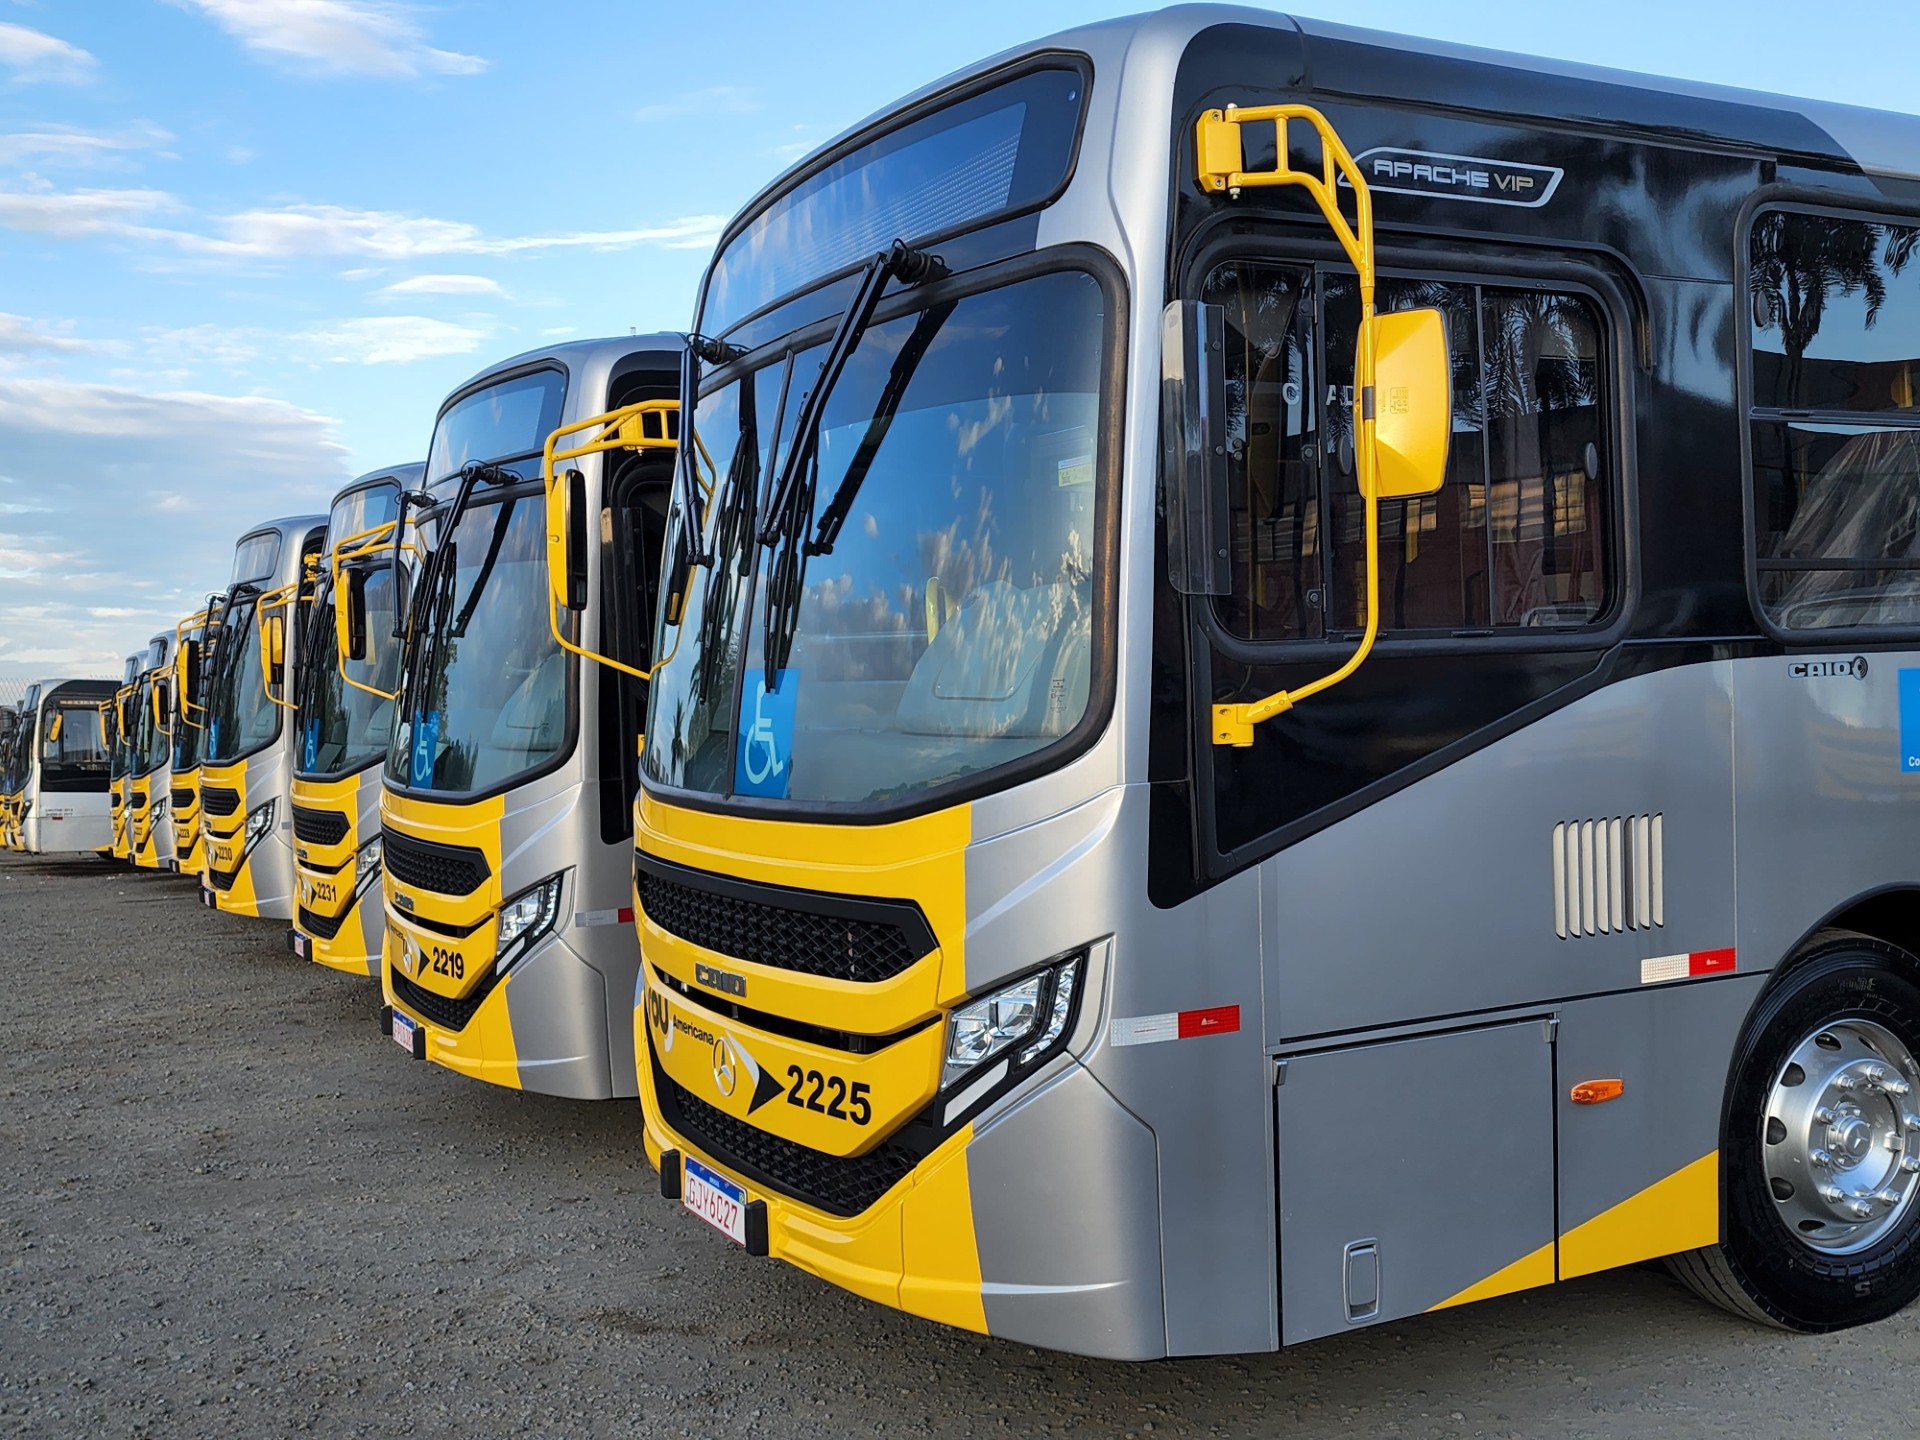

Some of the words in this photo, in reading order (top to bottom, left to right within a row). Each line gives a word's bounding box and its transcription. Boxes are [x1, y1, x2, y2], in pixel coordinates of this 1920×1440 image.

[1373, 159, 1489, 189] APACHE
[1493, 173, 1534, 192] VIP
[1788, 661, 1853, 679] CAIO
[316, 881, 337, 903] 2231
[432, 946, 465, 980] 2219
[673, 1013, 715, 1047] Americana
[786, 1063, 873, 1127] 2225
[689, 1177, 738, 1234] GJY6C27
